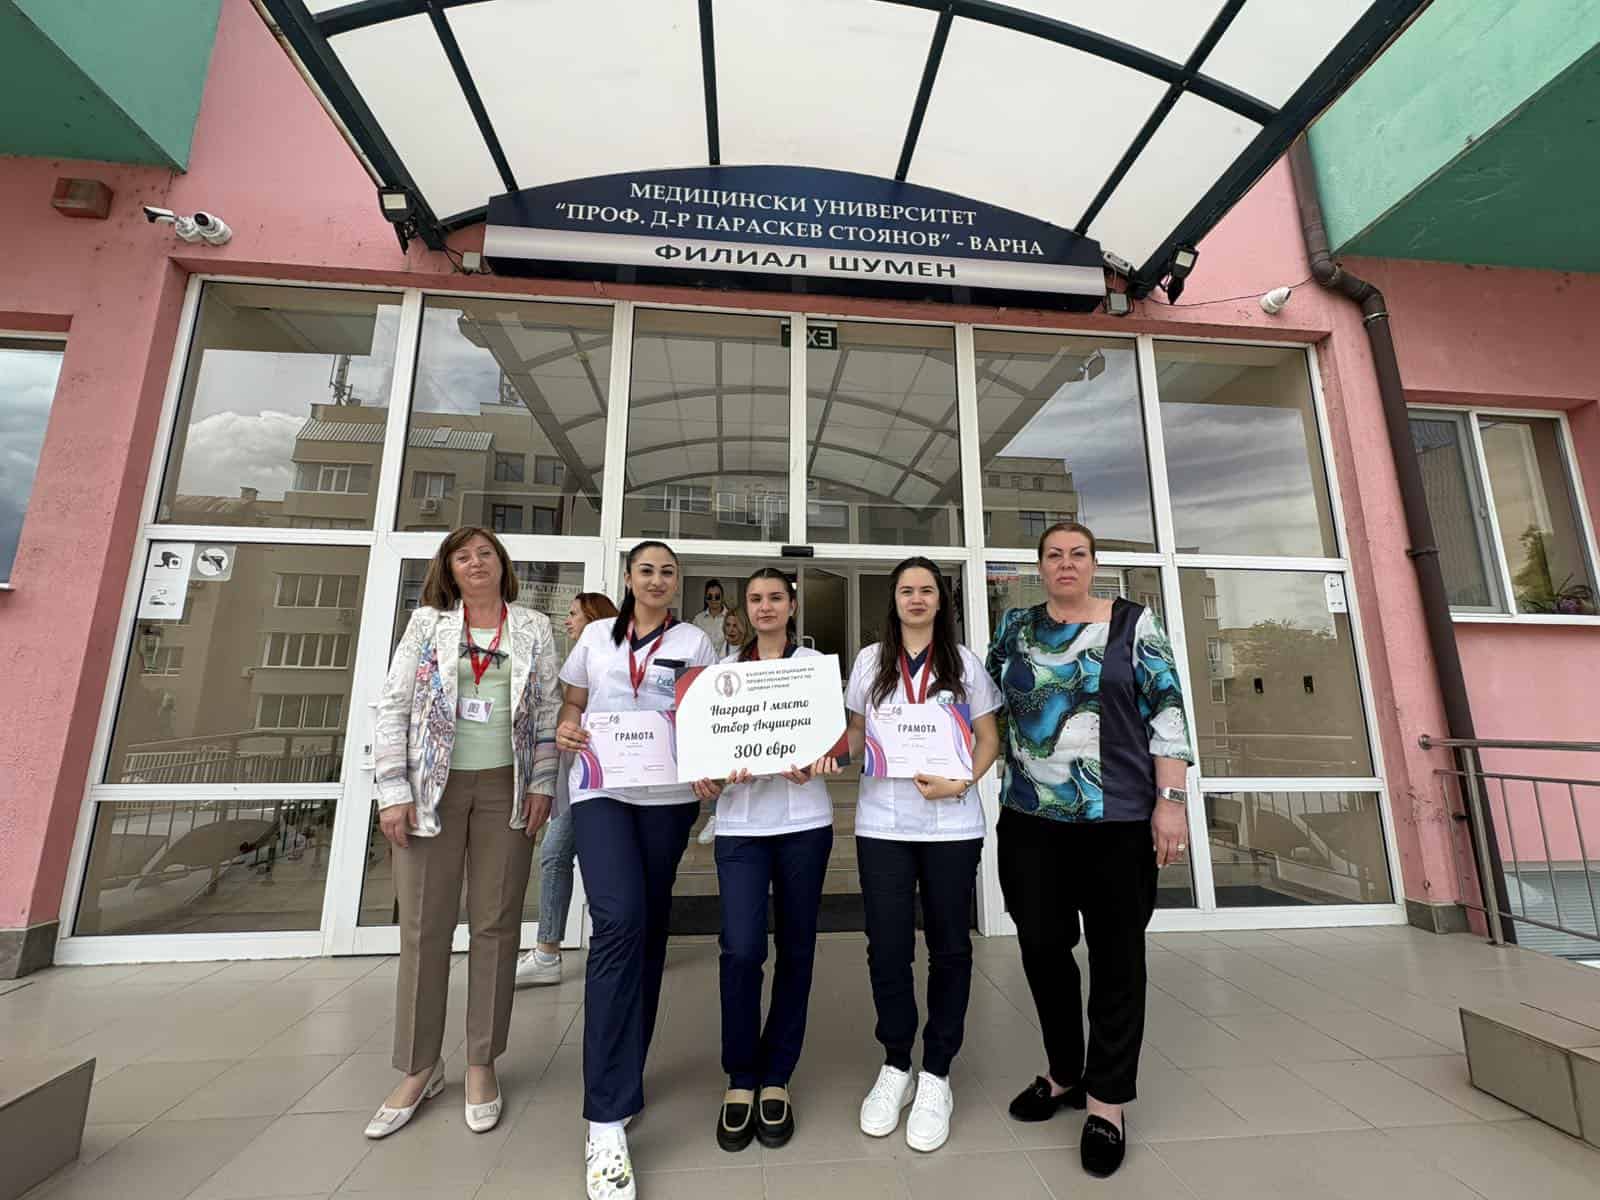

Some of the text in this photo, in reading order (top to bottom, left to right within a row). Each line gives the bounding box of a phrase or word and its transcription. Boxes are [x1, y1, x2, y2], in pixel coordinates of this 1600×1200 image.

[630, 182, 977, 226] МЕДИЦИНСКИ УНИВЕРСИТЕТ
[650, 210, 691, 230] Д-Р
[696, 214, 823, 238] ПАРАСКЕВ
[969, 235, 1044, 256] ВАРНА
[655, 244, 956, 278] ФИЛИАЛ ШУМЕН
[710, 703, 760, 717] Награда
[770, 699, 809, 711] място
[711, 717, 811, 735] Отбор Акушерки
[897, 724, 937, 733] ГРАМОТА
[615, 731, 654, 741] ГРАМОТА
[733, 741, 797, 759] 300 евро
